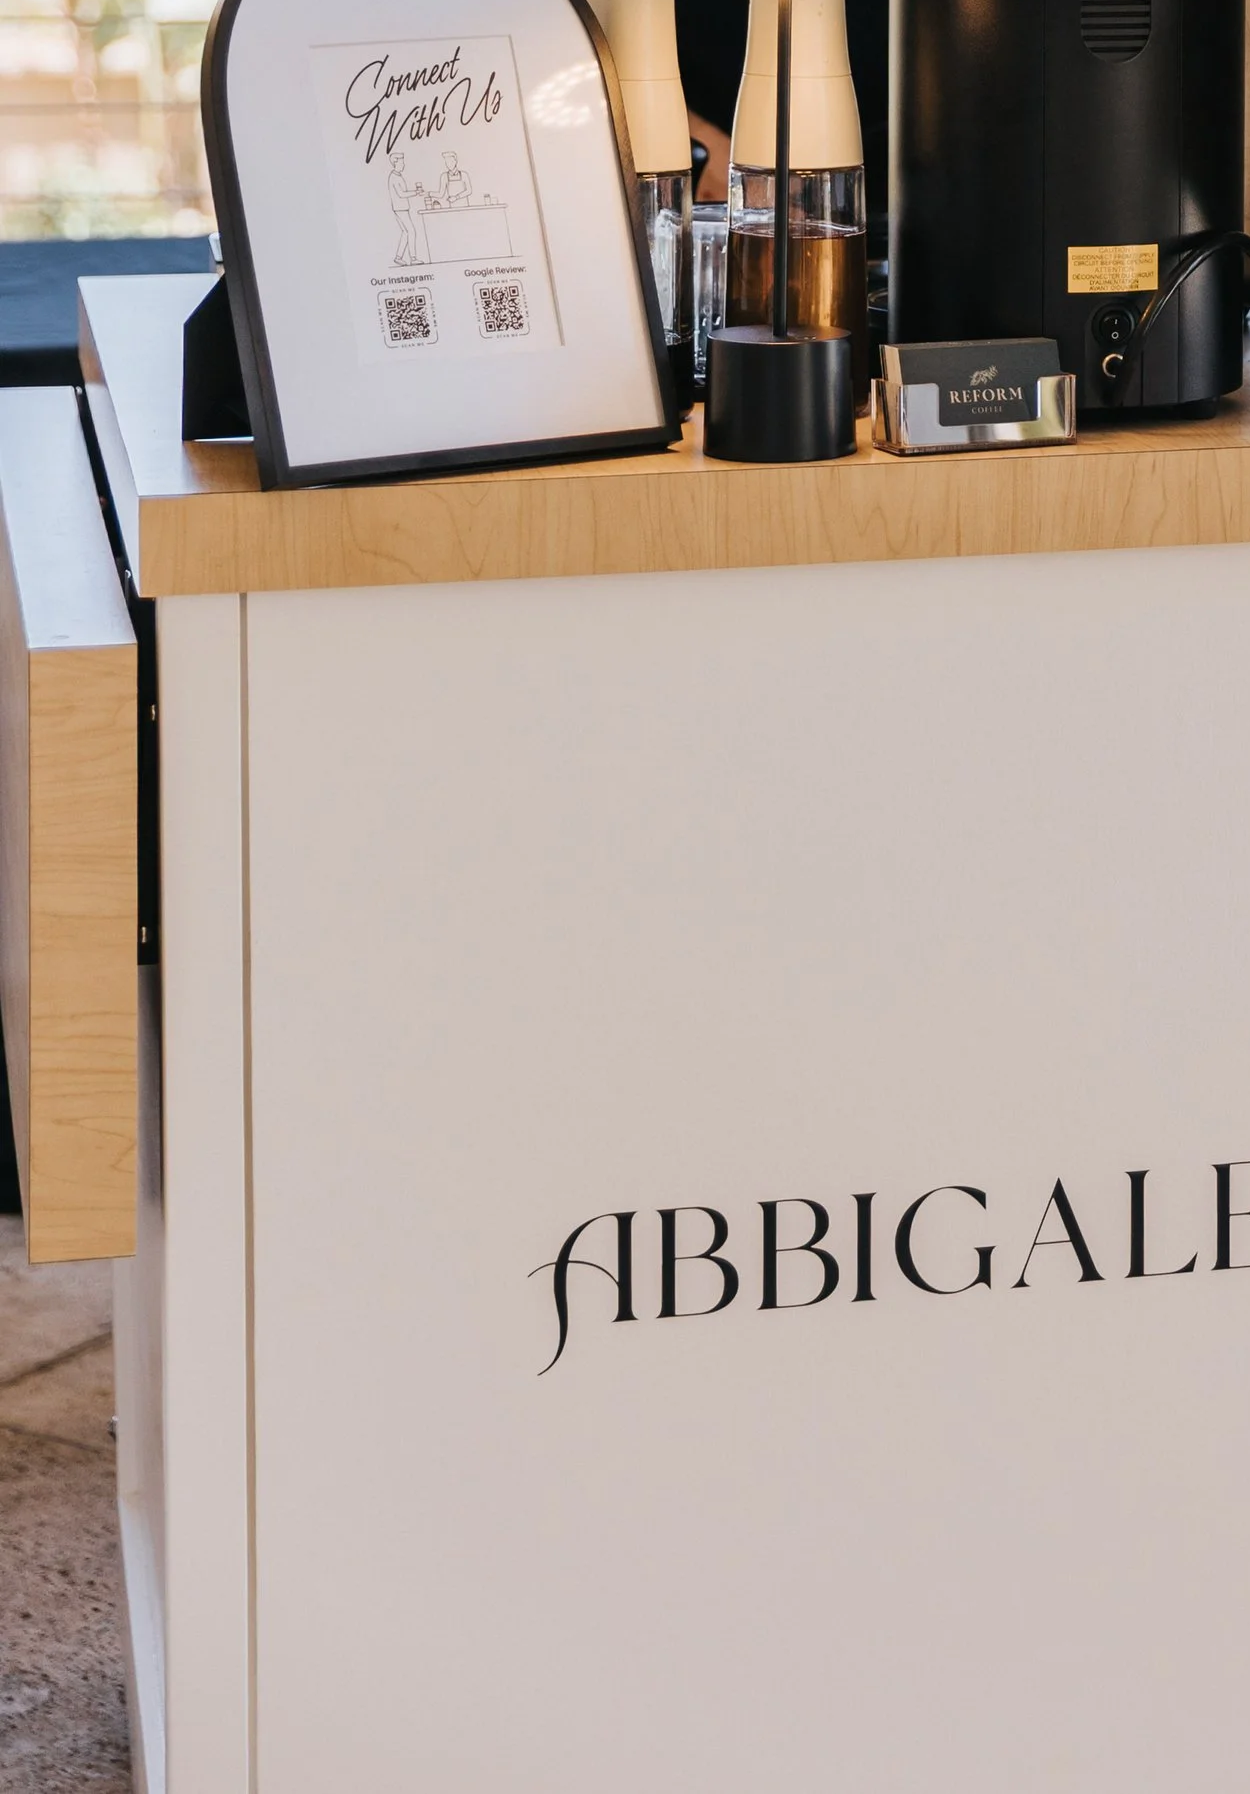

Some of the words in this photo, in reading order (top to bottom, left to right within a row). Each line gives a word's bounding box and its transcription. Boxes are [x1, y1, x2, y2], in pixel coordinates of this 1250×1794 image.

[345, 46, 460, 118] Connect
[355, 96, 446, 164] With
[442, 71, 503, 126] Us
[464, 267, 494, 278] Google
[495, 265, 527, 274] Review:
[370, 278, 388, 286] Our
[388, 274, 434, 287] Instagram:
[949, 387, 1023, 404] REFORM
